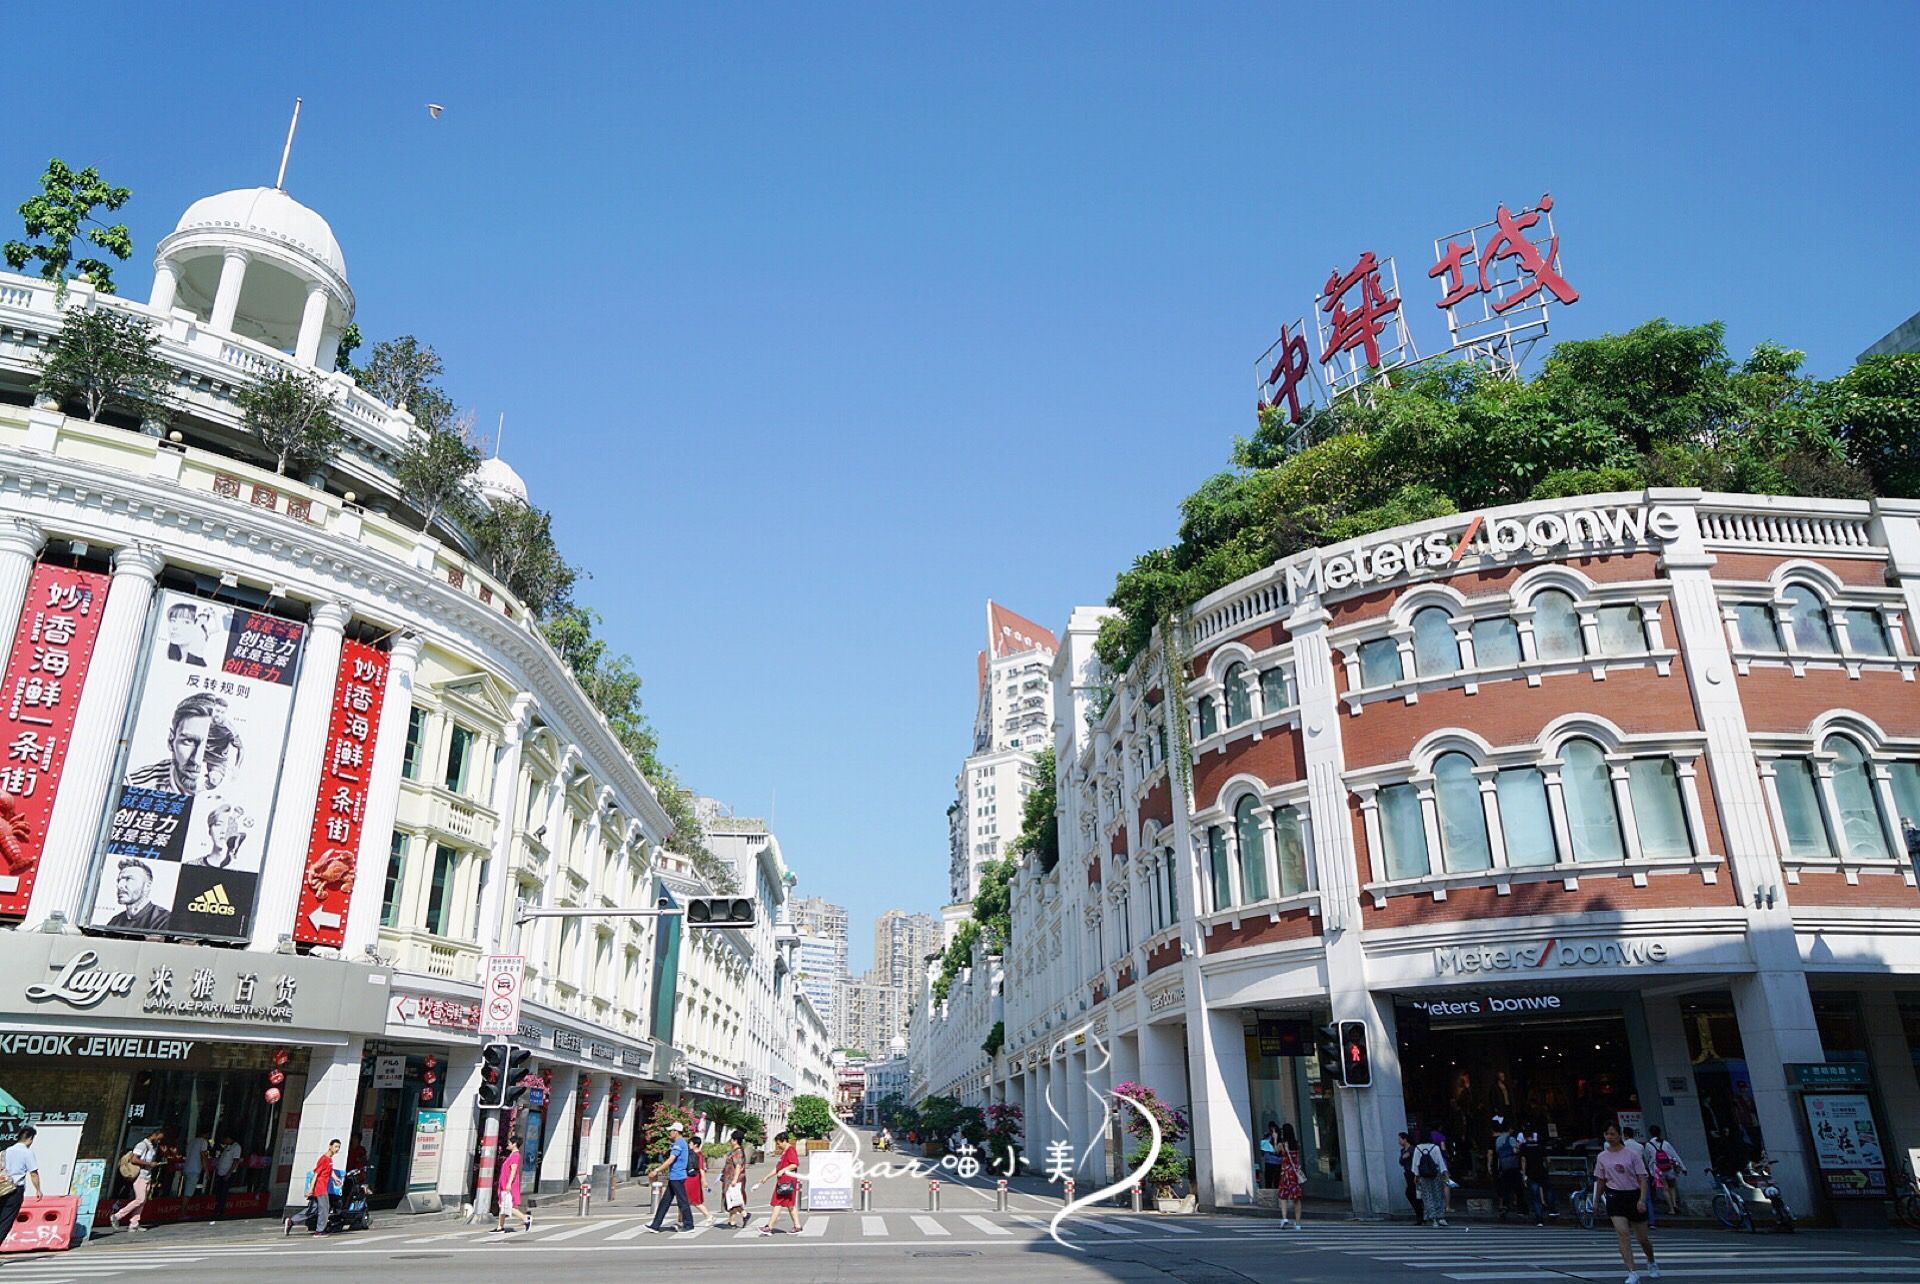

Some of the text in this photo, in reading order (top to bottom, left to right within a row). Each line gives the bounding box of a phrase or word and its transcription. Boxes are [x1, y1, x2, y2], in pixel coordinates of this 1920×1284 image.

[239, 630, 296, 656] 创造力
[232, 646, 290, 668] 就是答案
[223, 658, 282, 682] 创造力
[186, 674, 251, 699] 反转规则
[113, 808, 180, 834] 创造力
[187, 901, 236, 916] adidas
[25, 950, 137, 1006] Laiya
[78, 1038, 195, 1060] JEWELLERY
